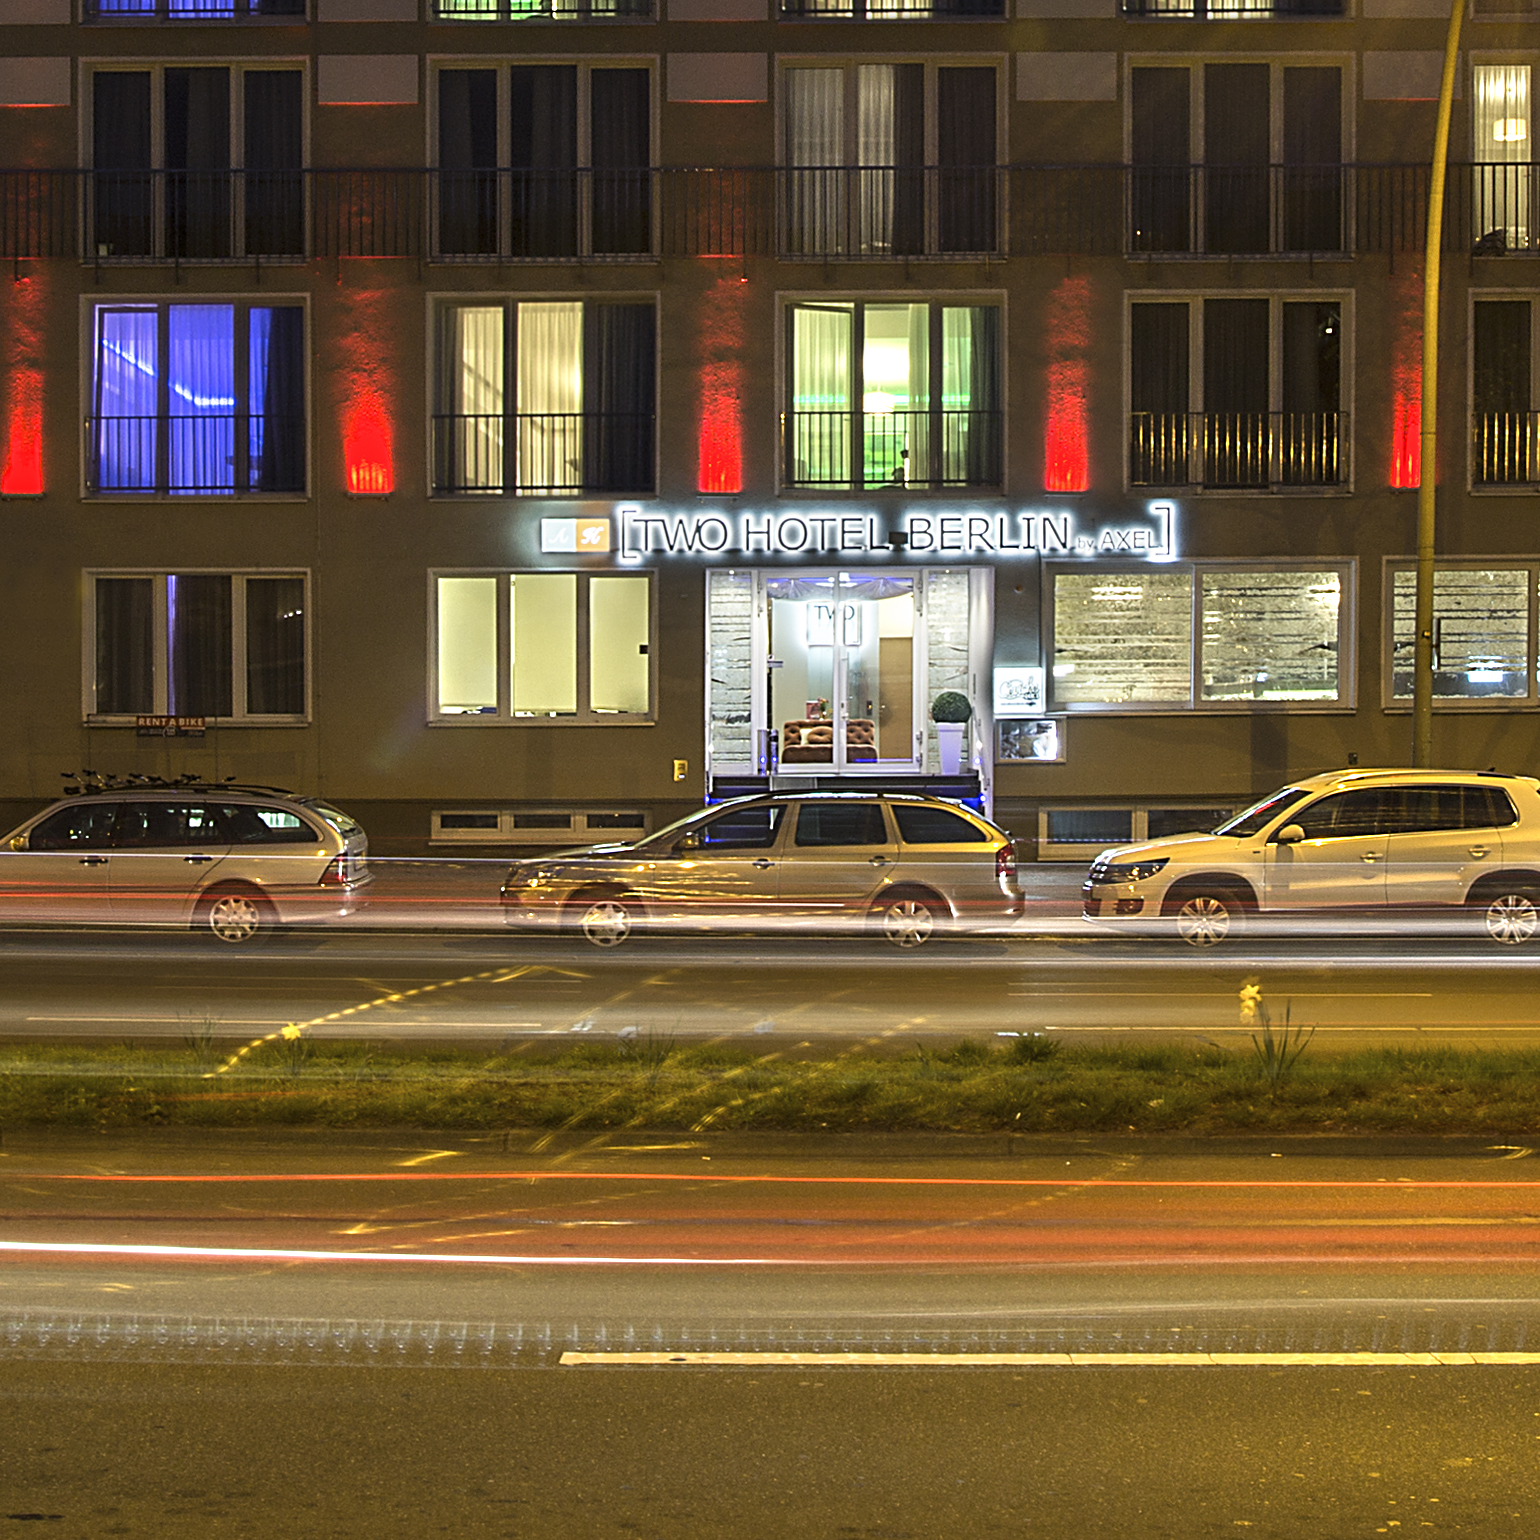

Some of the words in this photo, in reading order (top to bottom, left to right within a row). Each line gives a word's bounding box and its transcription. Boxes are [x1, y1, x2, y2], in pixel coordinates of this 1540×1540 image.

[745, 517, 890, 551] HOTEL
[910, 516, 1068, 551] BERLIN
[1077, 537, 1095, 551] by
[138, 717, 167, 726] RENT
[169, 717, 177, 726] A
[178, 717, 204, 726] BIKE
